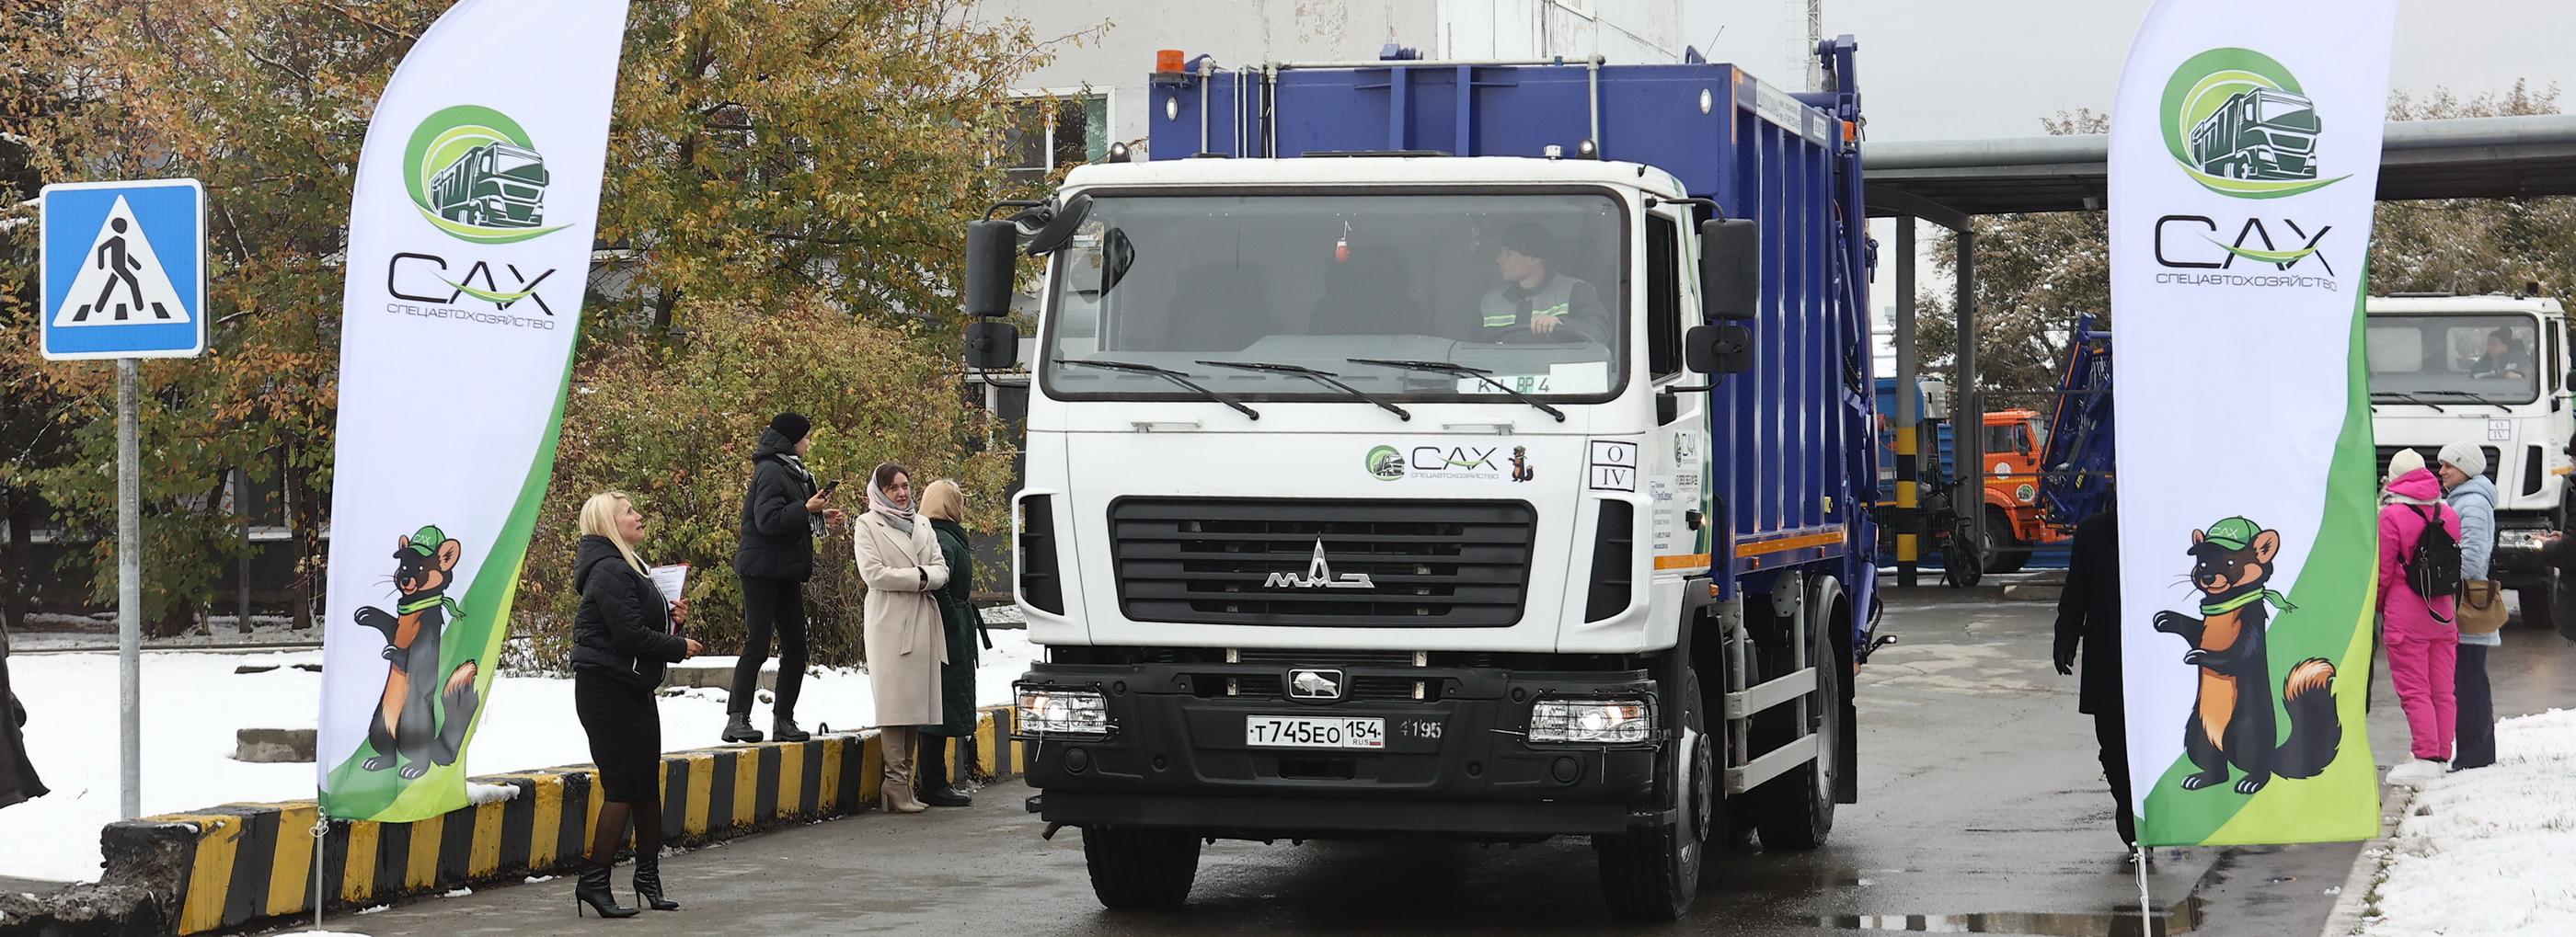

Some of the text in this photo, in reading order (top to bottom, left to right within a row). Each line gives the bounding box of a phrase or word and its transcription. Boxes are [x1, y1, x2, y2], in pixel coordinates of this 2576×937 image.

[2155, 214, 2335, 277] САХ
[387, 252, 557, 316] САХ
[2156, 273, 2338, 292] СПЕЦАВТОХОЗЯЙСТВО
[386, 303, 555, 330] СПЕЦАВТОХОЗЯЙСТВО
[1411, 446, 1498, 471] САХ
[1410, 472, 1500, 480] СПЕЦАВТОХОЗЯЙСТВО
[1602, 469, 1627, 486] IV
[1264, 531, 1375, 588] МАЗ
[1255, 720, 1378, 743] Т745ЕО 154
